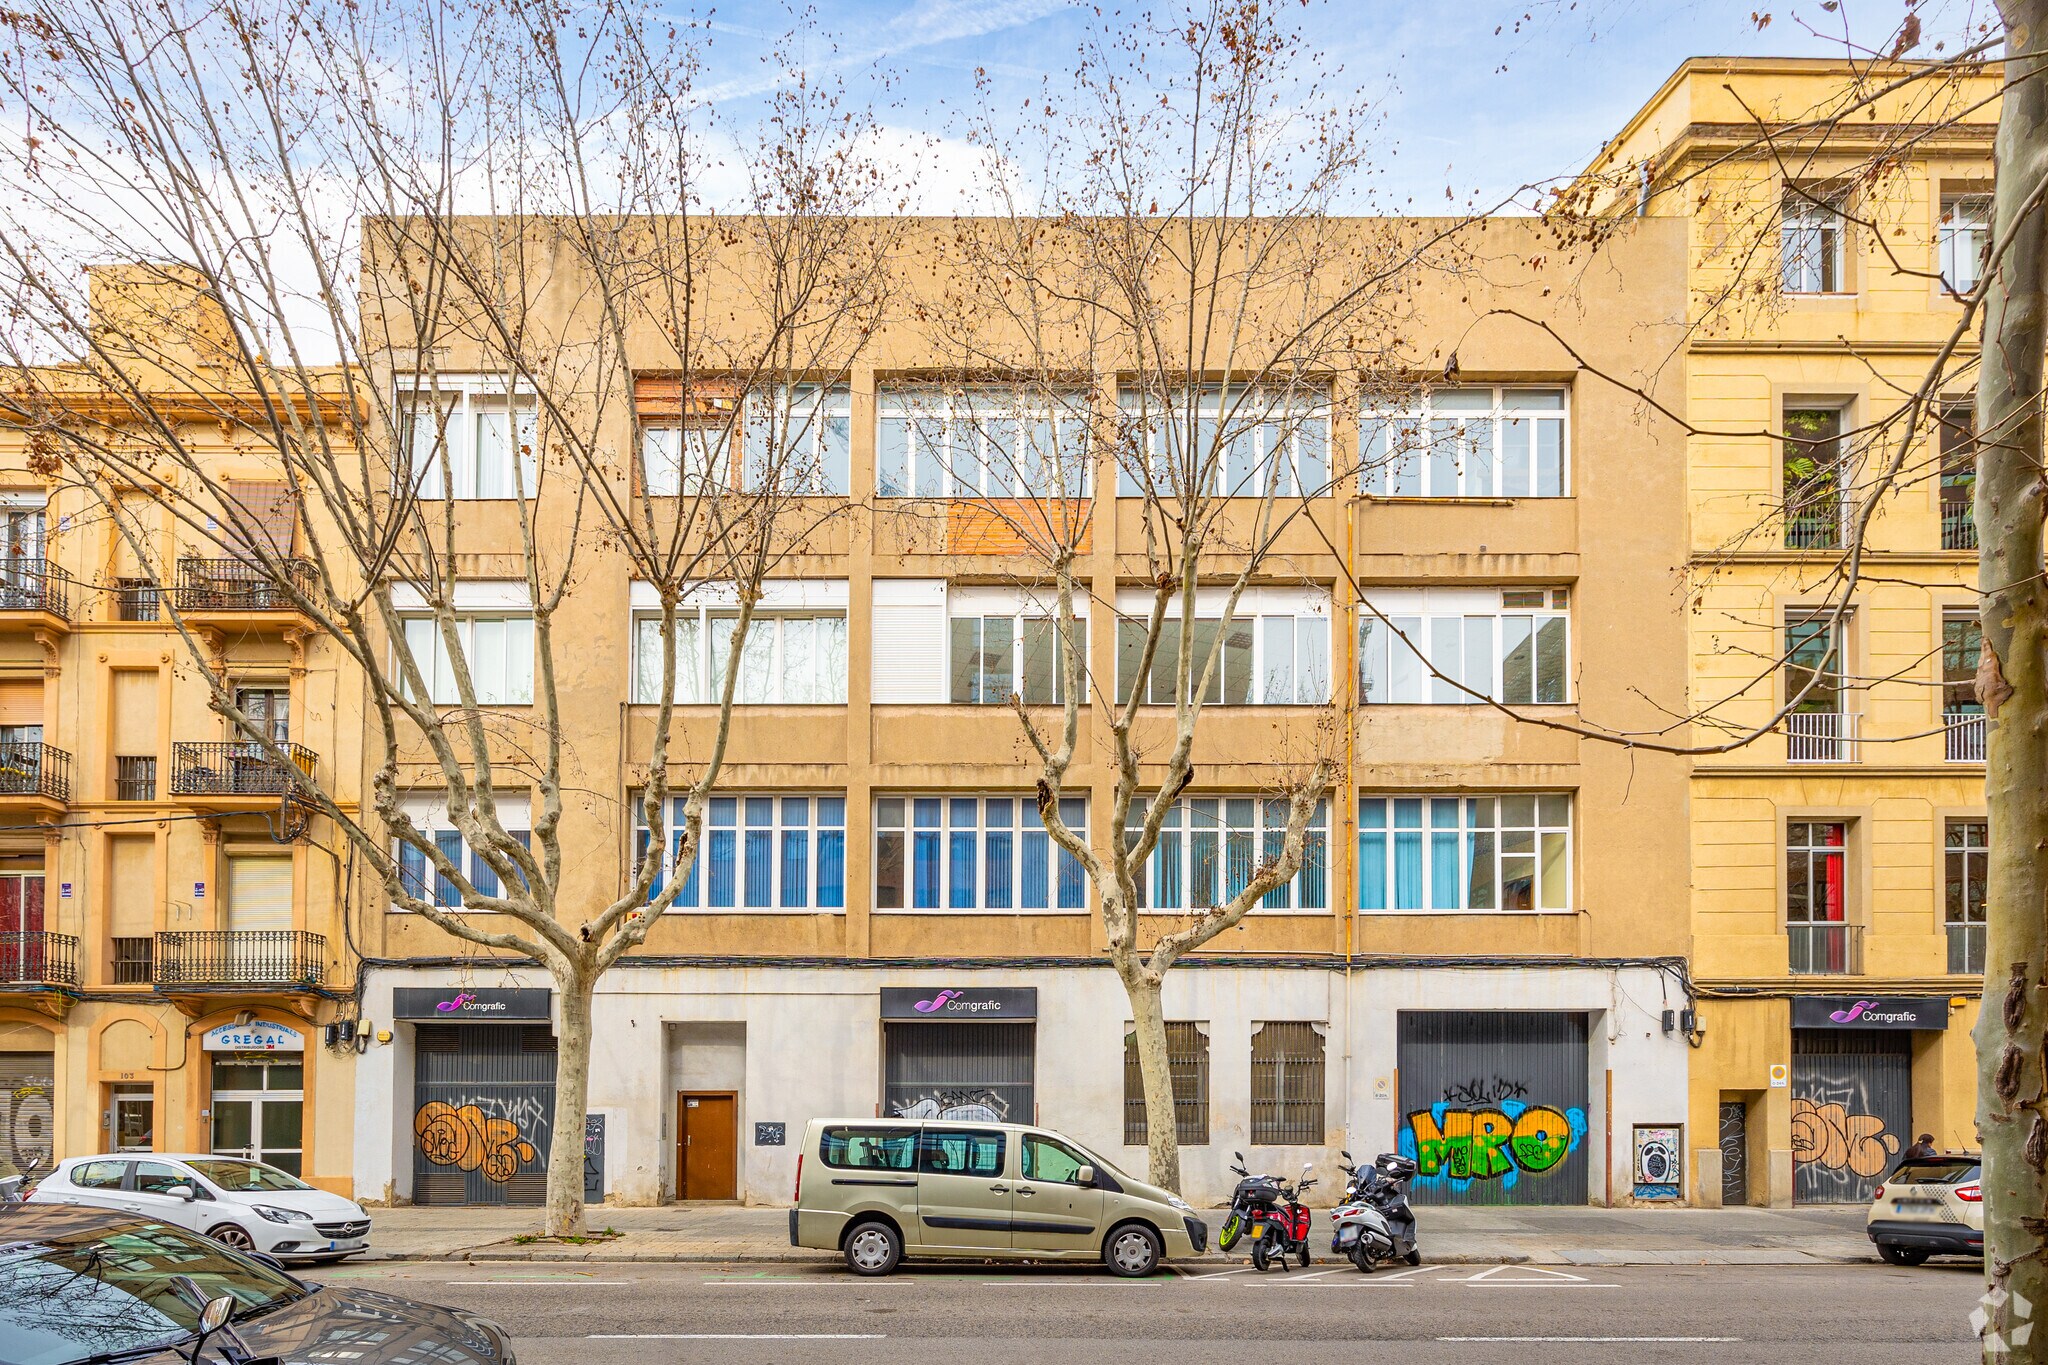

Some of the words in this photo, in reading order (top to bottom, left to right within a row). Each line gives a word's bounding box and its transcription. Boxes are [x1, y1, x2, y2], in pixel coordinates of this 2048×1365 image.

[463, 1001, 506, 1012] Comgrafic
[947, 1000, 1001, 1012] Comgrafic
[1862, 1010, 1917, 1024] Comgrafic
[211, 1022, 252, 1037] ACCESSS
[255, 1021, 298, 1038] INDUSTRIALS
[221, 1034, 285, 1045] GREGAL
[120, 1072, 135, 1080] 103
[1407, 1104, 1571, 1181] MRO
